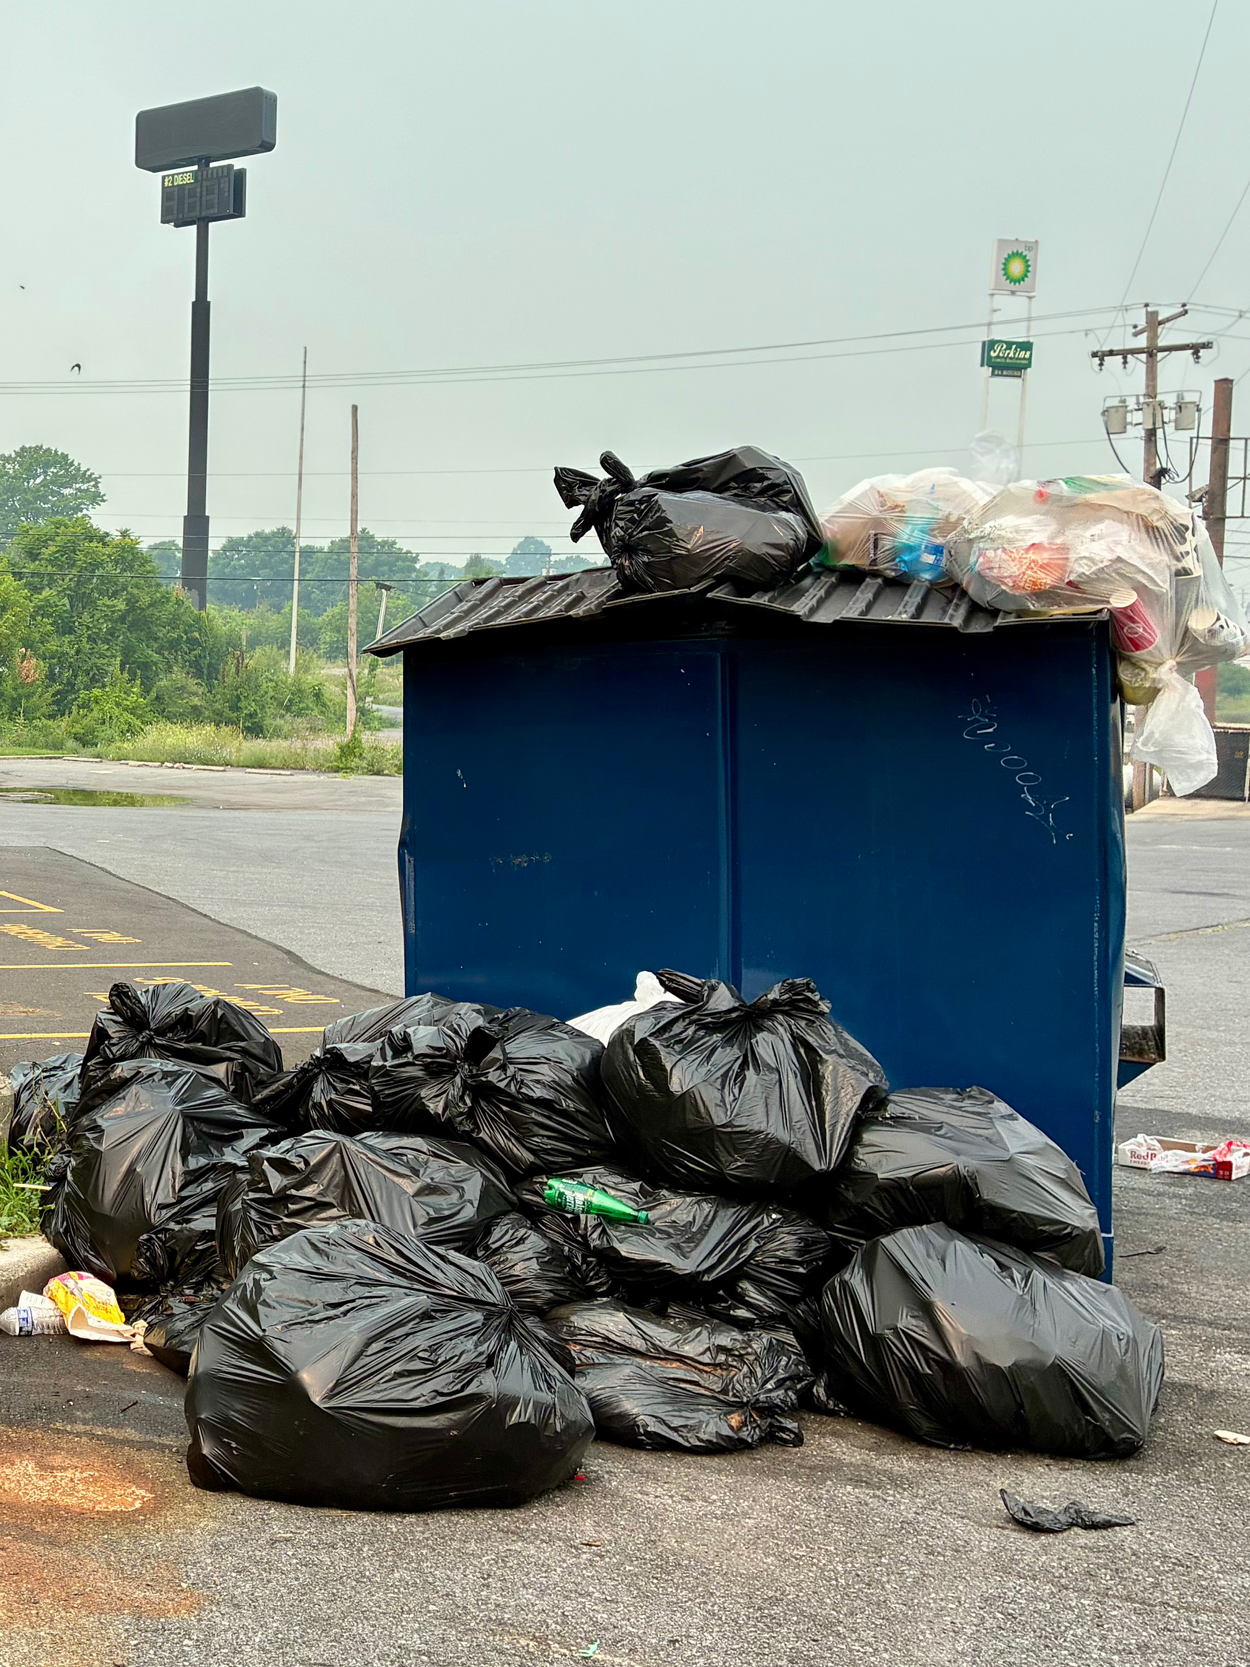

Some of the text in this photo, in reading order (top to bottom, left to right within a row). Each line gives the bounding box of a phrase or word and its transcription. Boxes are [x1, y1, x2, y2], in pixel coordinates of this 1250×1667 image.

[164, 173, 194, 187] #2 DIESEL
[1024, 244, 1034, 253] bp
[990, 342, 1031, 359] Perkins
[65, 928, 143, 943] ONLY
[233, 983, 341, 1004] ONLY
[1130, 1150, 1150, 1161] Red
